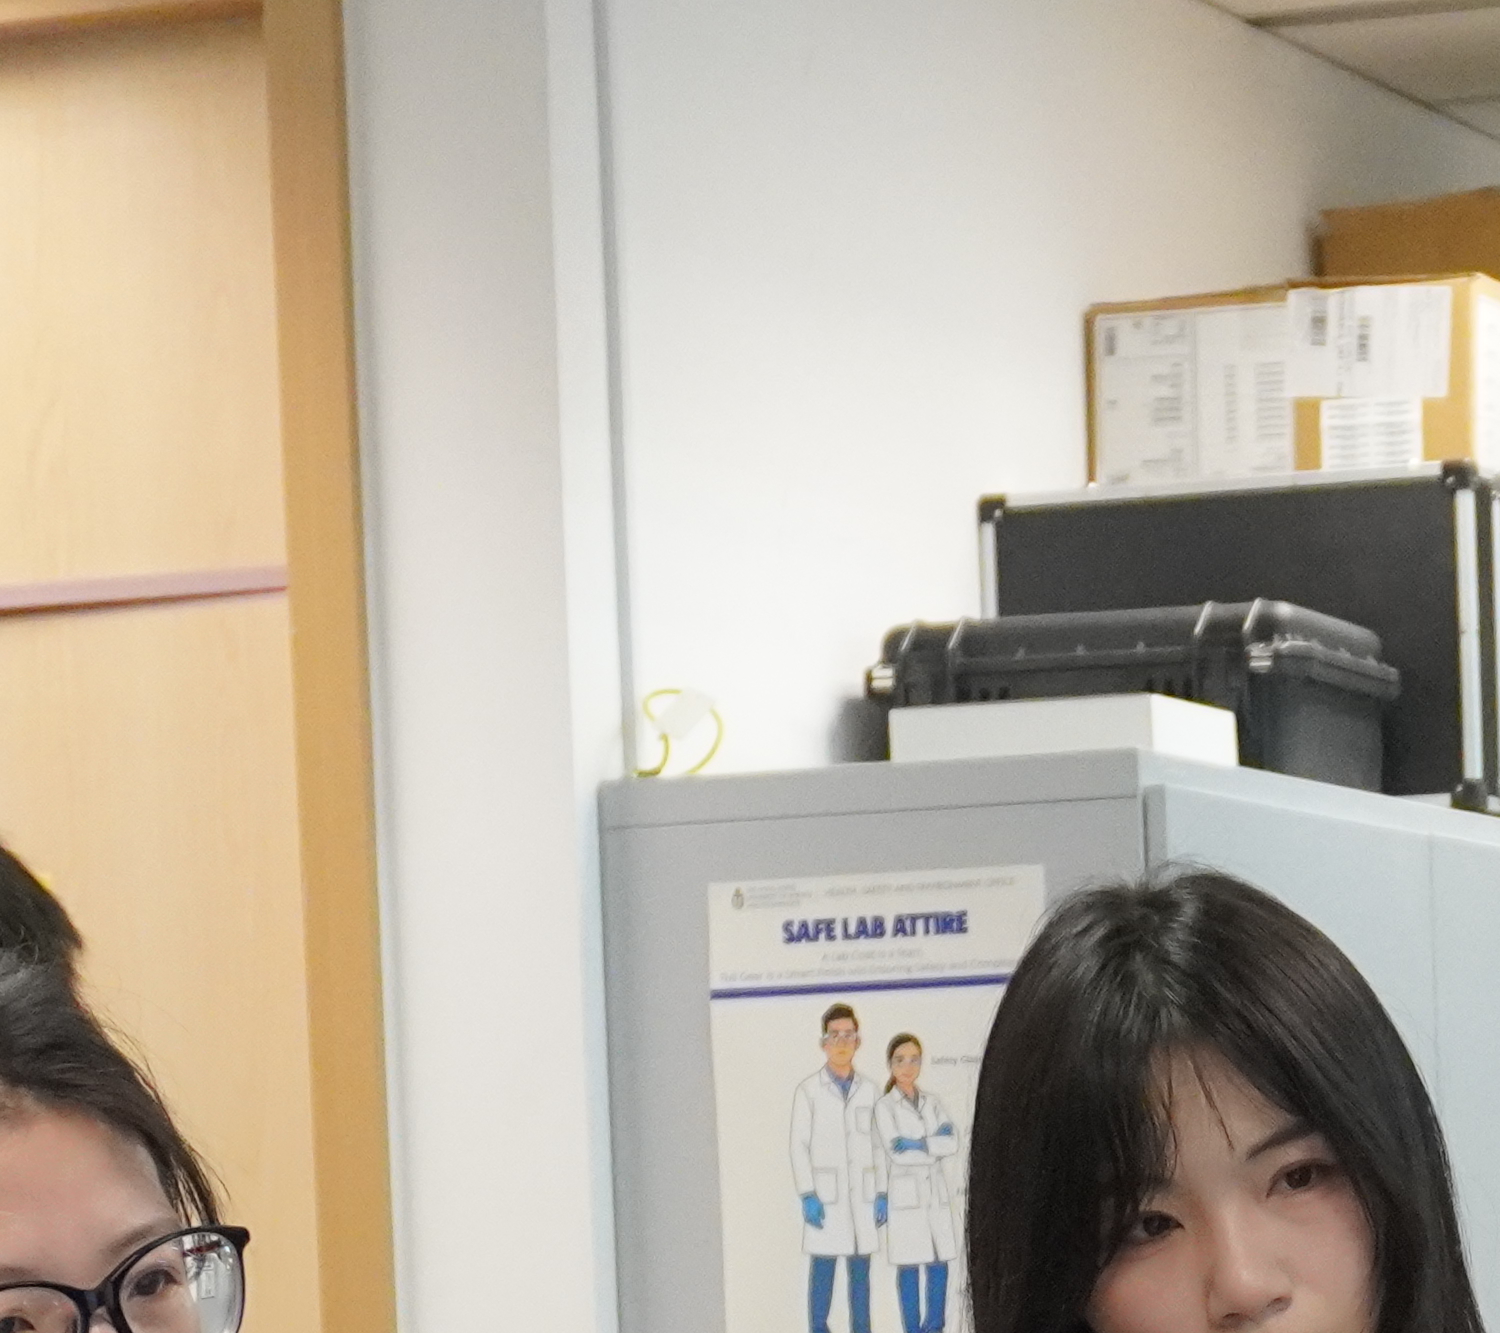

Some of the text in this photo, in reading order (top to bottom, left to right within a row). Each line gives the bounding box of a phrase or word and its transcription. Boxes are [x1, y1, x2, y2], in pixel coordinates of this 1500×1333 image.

[782, 909, 969, 945] SAFE LAB ATTIRE
